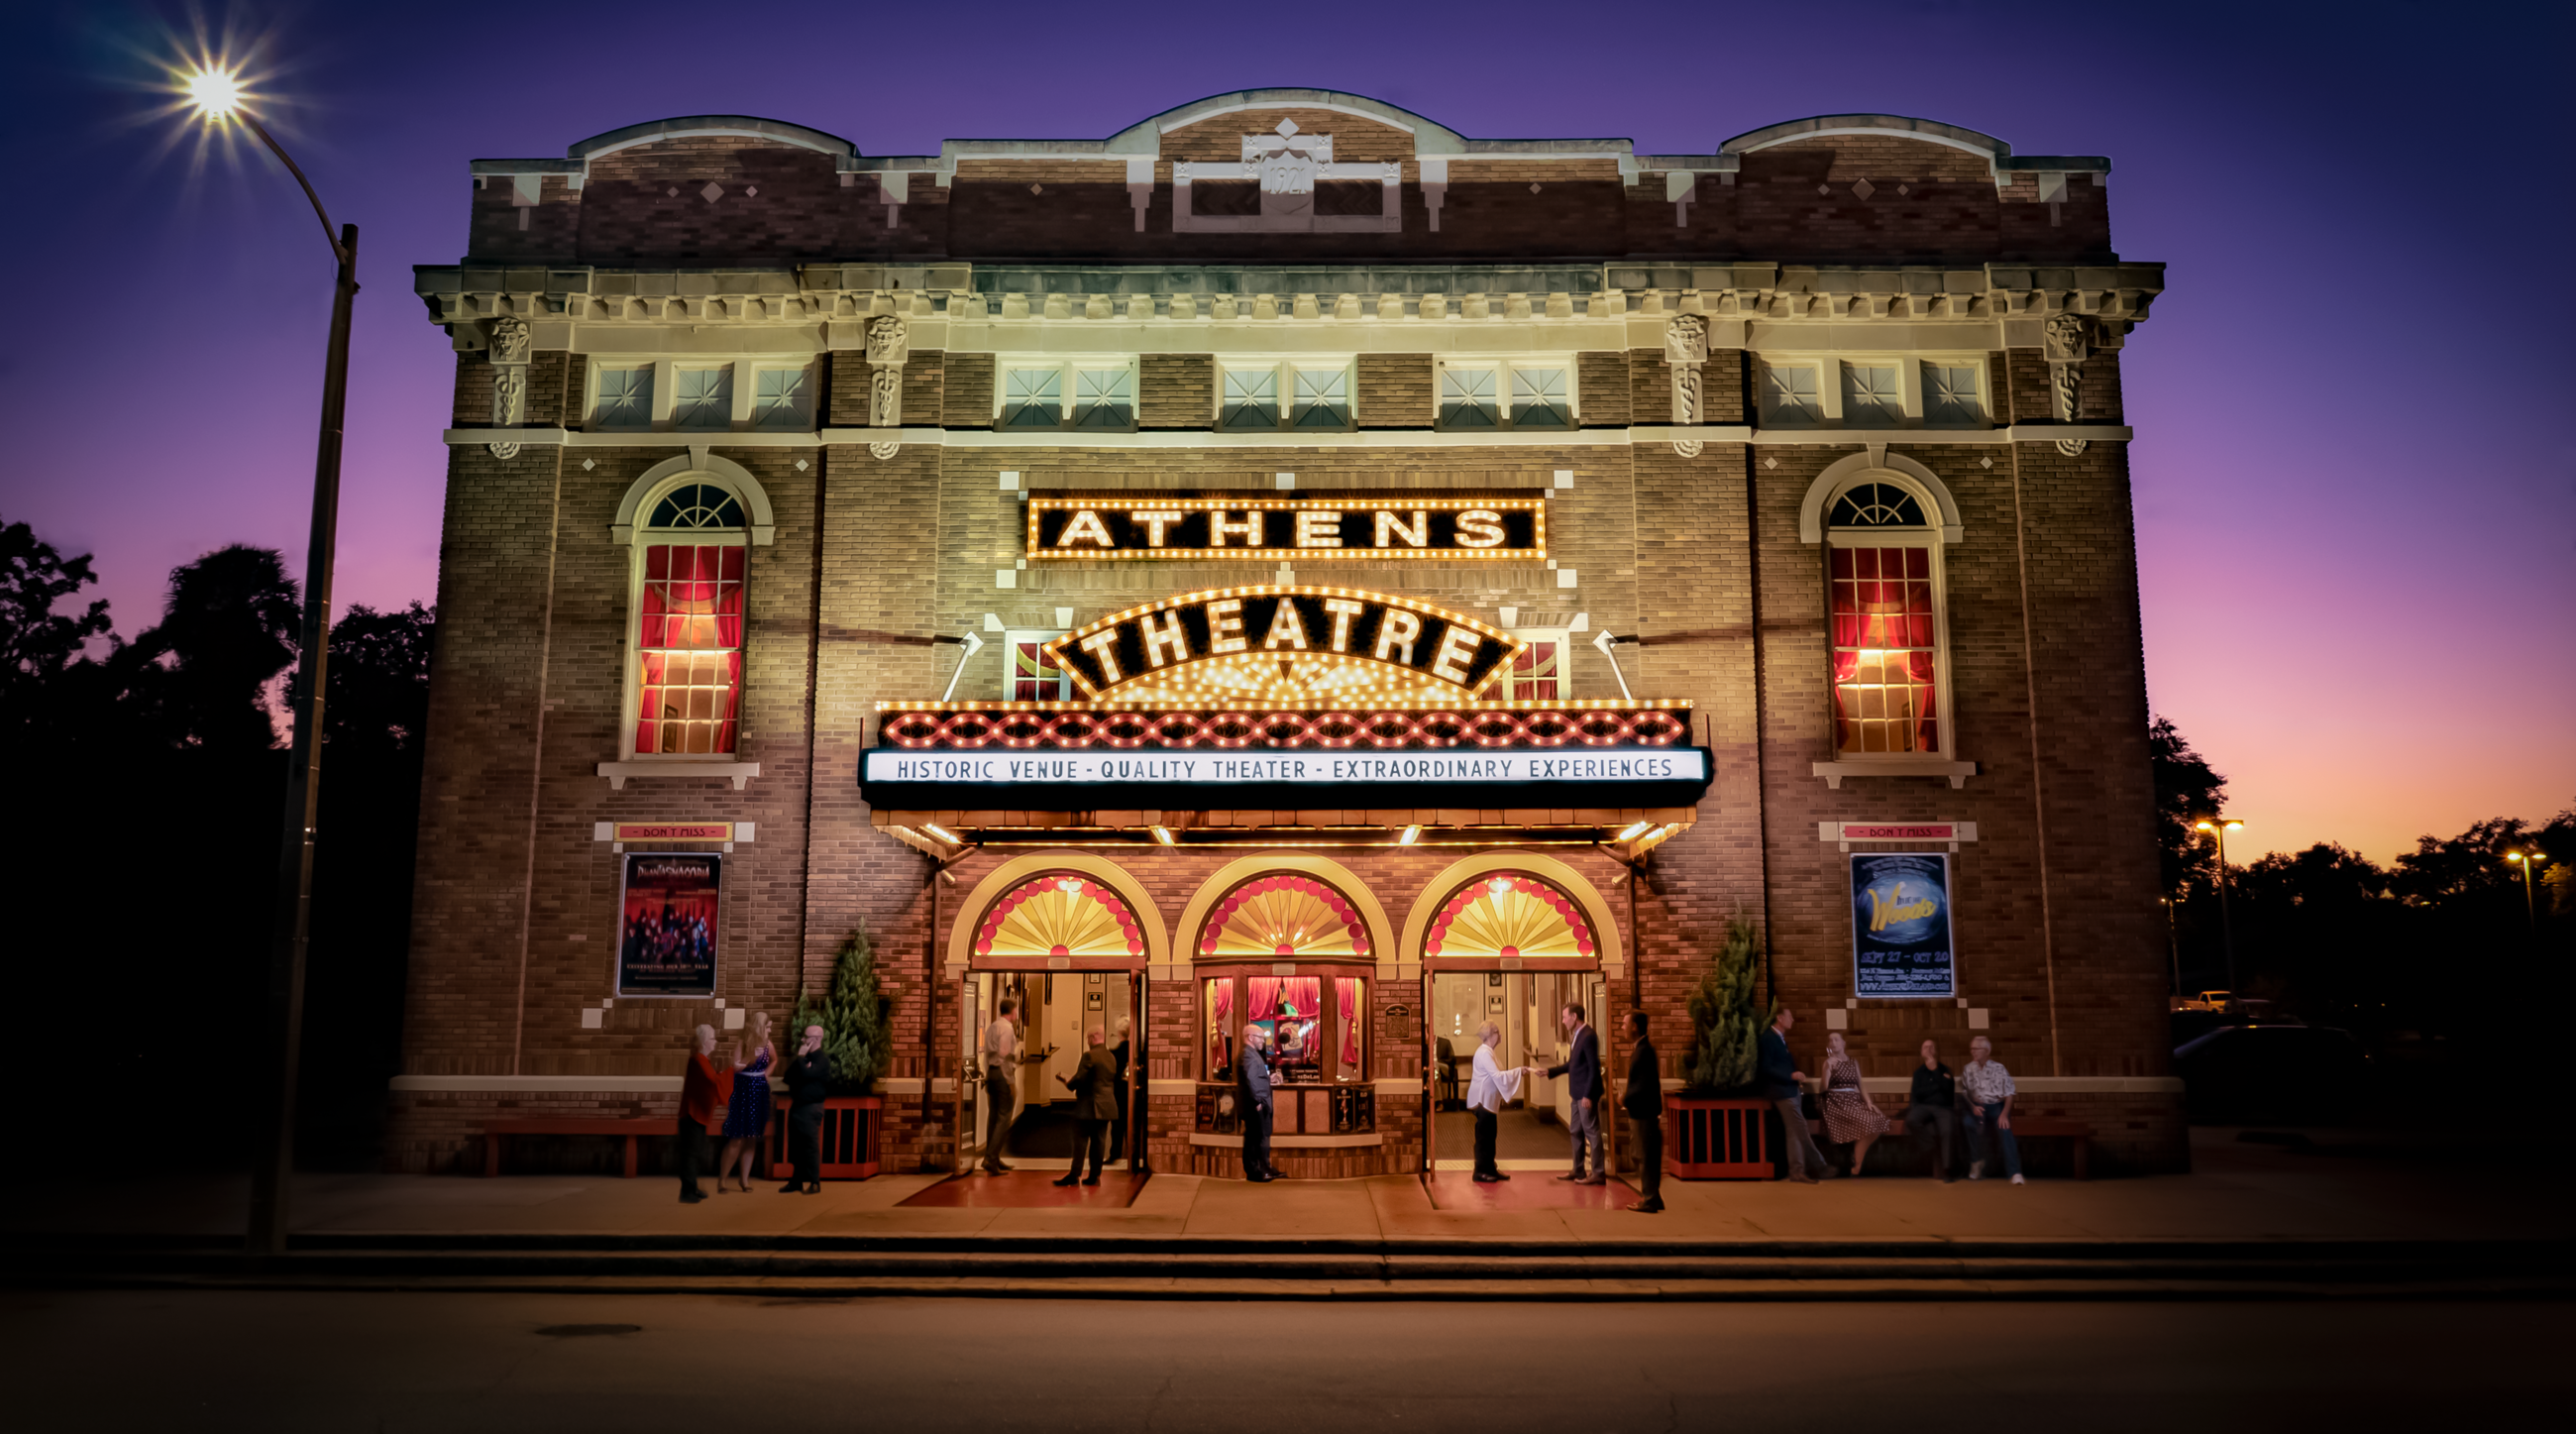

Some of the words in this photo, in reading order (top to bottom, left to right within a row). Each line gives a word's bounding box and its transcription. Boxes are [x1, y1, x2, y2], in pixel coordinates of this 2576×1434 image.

[1269, 166, 1307, 195] 1921
[1056, 509, 1507, 548] ATHENS
[1080, 597, 1482, 686] THEATRE
[897, 760, 995, 779] HISTORIC
[1010, 760, 1078, 779] VENUE
[1101, 760, 1196, 779] QUALITY
[1213, 760, 1306, 779] THEATER
[1333, 759, 1513, 778] EXTRAORDINARY
[1529, 758, 1672, 778] EXPERIENCES
[643, 827, 677, 837] DON'T
[680, 828, 705, 837] MISS
[1870, 827, 1903, 837] DON'T
[1907, 828, 1932, 837] MISS
[1860, 950, 1885, 964] SEPT
[1886, 951, 1901, 962] 27
[1913, 951, 1932, 963] OCT
[1934, 950, 1949, 962] 20
